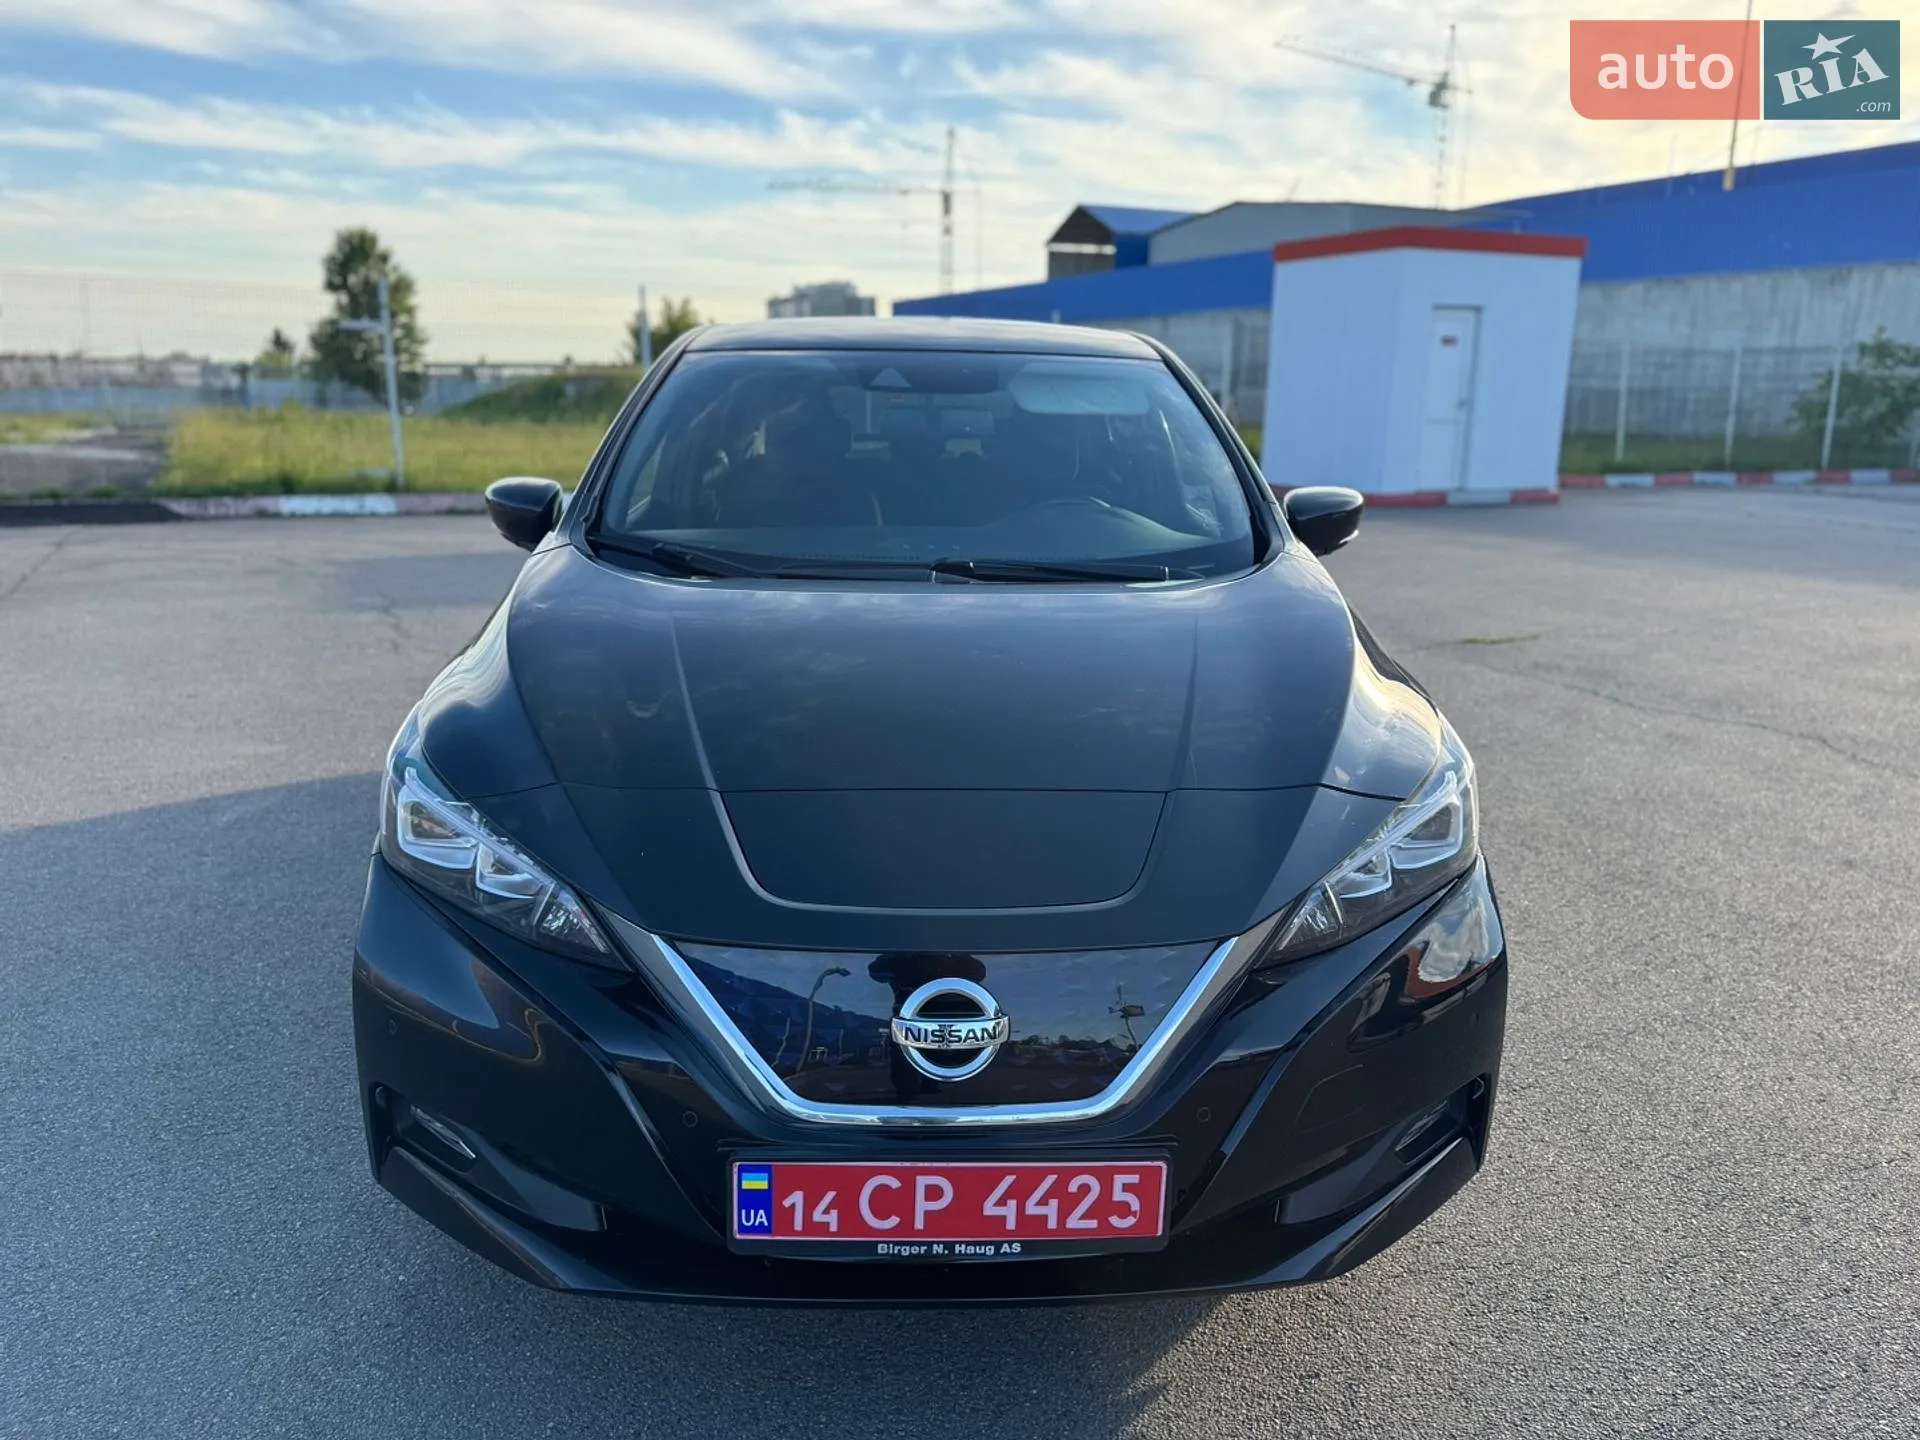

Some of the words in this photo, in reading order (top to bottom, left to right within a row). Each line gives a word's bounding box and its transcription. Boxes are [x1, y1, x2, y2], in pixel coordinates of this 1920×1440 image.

[904, 1026, 998, 1043] NISSAN
[781, 1190, 838, 1232] 14
[858, 1174, 955, 1231] CP
[982, 1174, 1141, 1231] 4425
[741, 1209, 768, 1227] UA
[877, 1243, 928, 1256] Birger
[932, 1243, 949, 1255] N.
[955, 1243, 995, 1256] Haug
[999, 1242, 1022, 1254] AS
